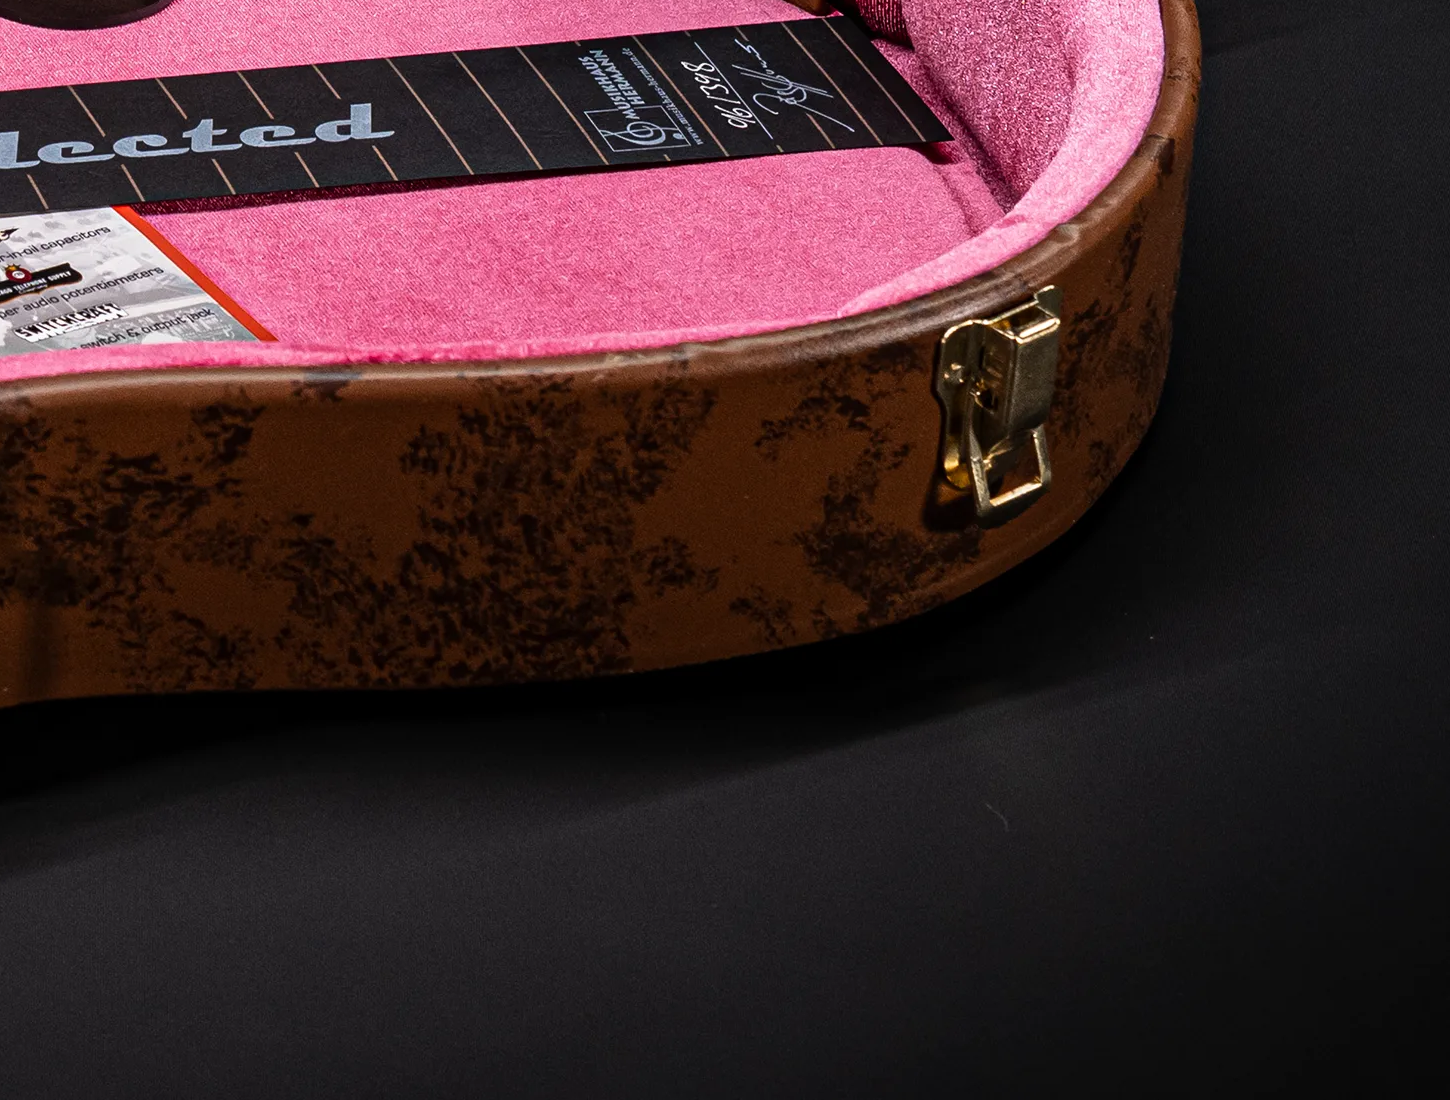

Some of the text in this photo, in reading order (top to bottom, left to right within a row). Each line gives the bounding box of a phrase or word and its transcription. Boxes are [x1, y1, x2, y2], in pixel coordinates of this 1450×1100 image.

[578, 55, 640, 121] MUSIKHAUS
[589, 49, 646, 106] HERMANN
[681, 60, 758, 131] 961398
[42, 226, 111, 252] capacitors
[25, 295, 60, 312] audio
[63, 266, 164, 302] potentiometers
[16, 302, 127, 341] SWITCHCRAFT
[141, 316, 187, 336] output
[187, 306, 216, 324] jack
